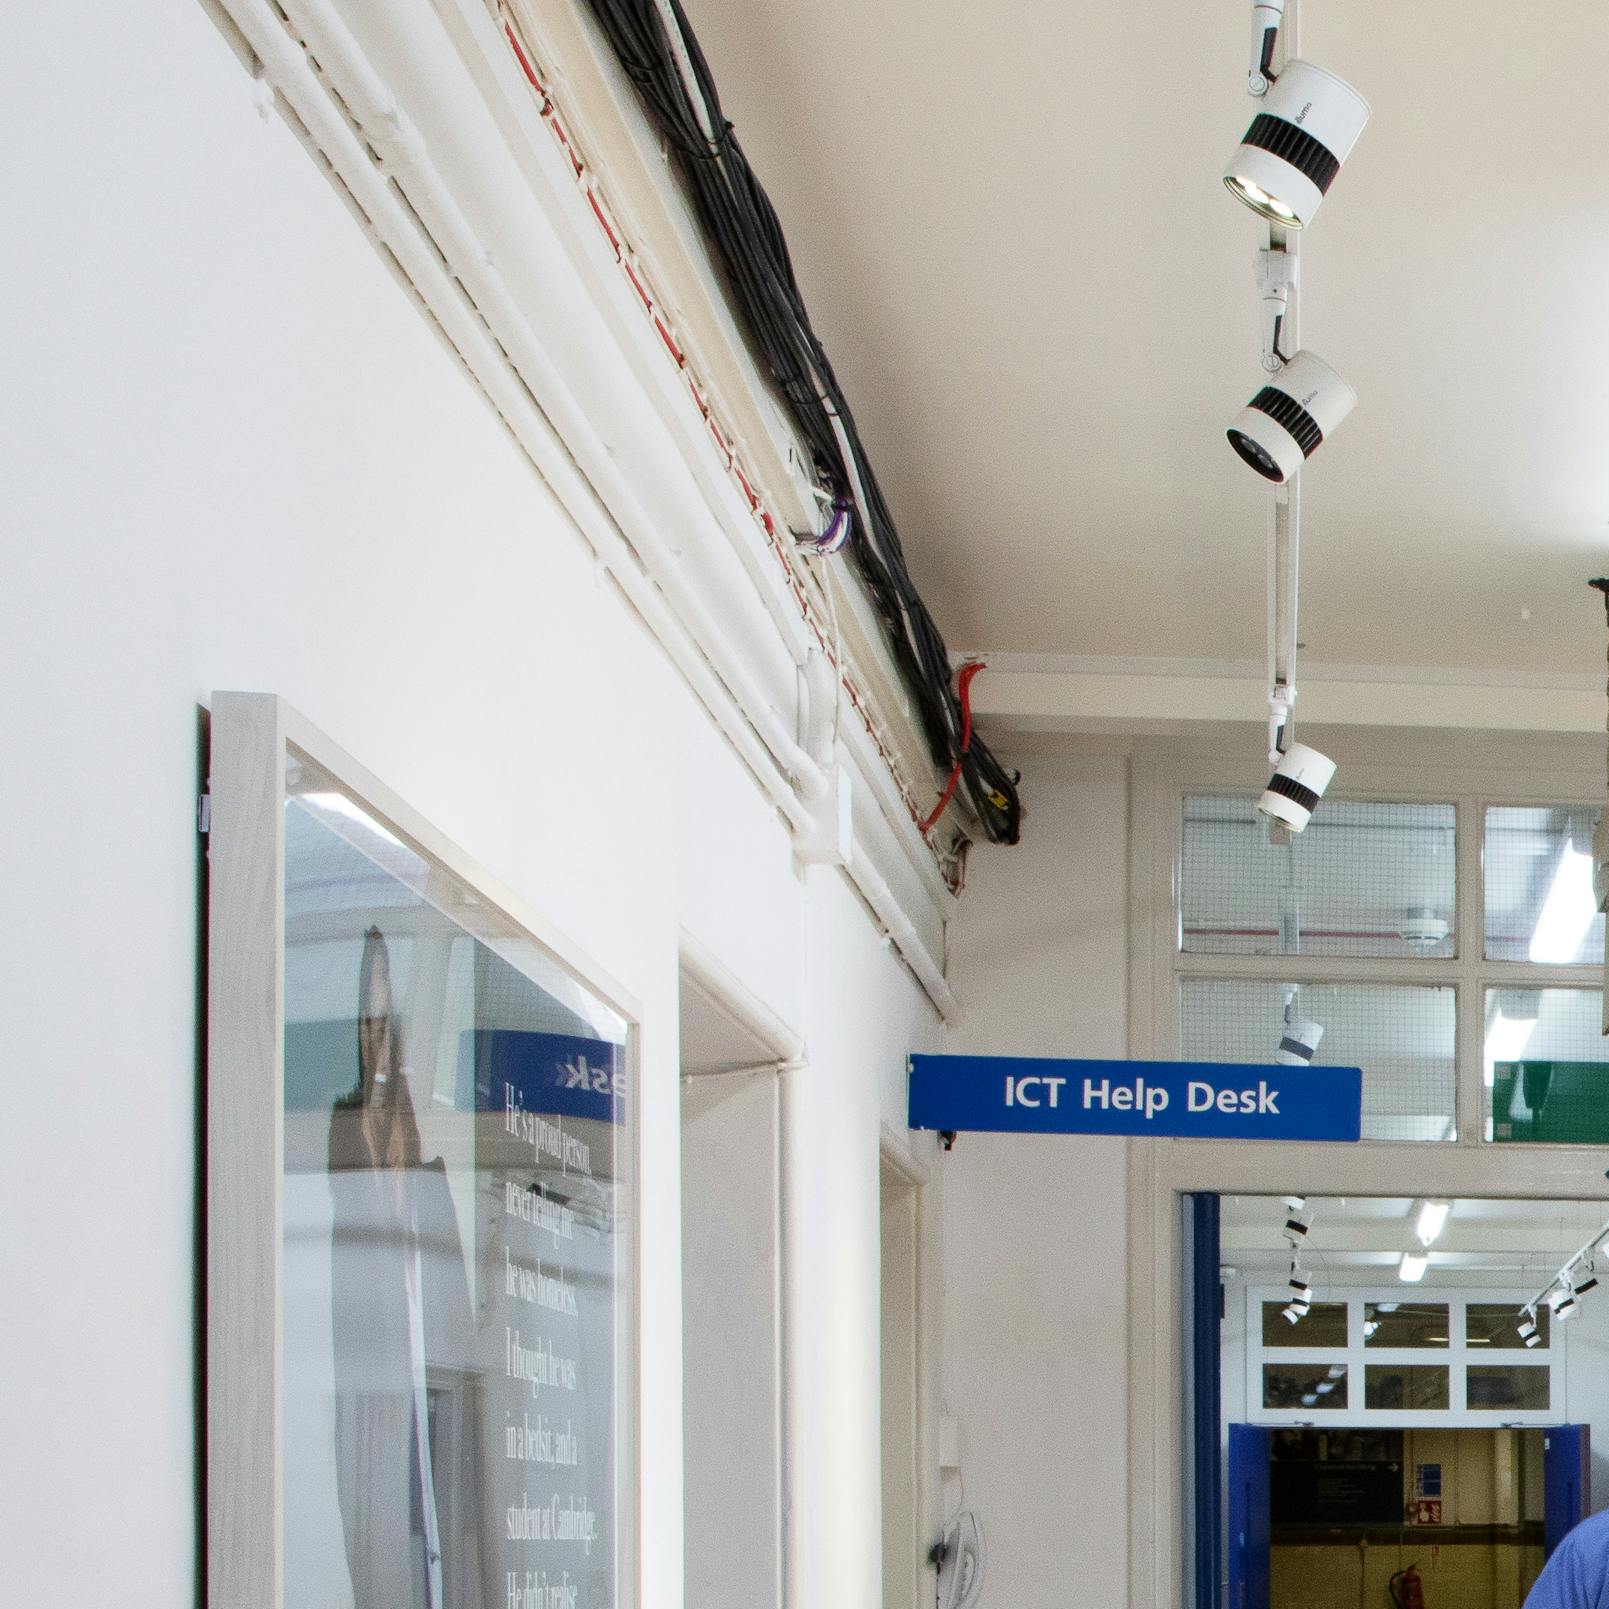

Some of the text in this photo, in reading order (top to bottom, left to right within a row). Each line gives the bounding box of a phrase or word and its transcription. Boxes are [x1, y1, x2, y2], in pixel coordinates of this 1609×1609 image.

[1005, 1076, 1280, 1119] ICT Help Desk
[535, 1115, 561, 1163] proud
[506, 1182, 573, 1250] never telling me
[506, 1246, 517, 1297] he
[519, 1268, 536, 1303] was
[506, 1327, 576, 1399] I thought he was
[506, 1411, 516, 1459] in
[517, 1431, 524, 1459] a
[556, 1420, 570, 1464] and
[572, 1434, 577, 1466] a
[507, 1492, 540, 1541] student
[542, 1508, 551, 1540] at
